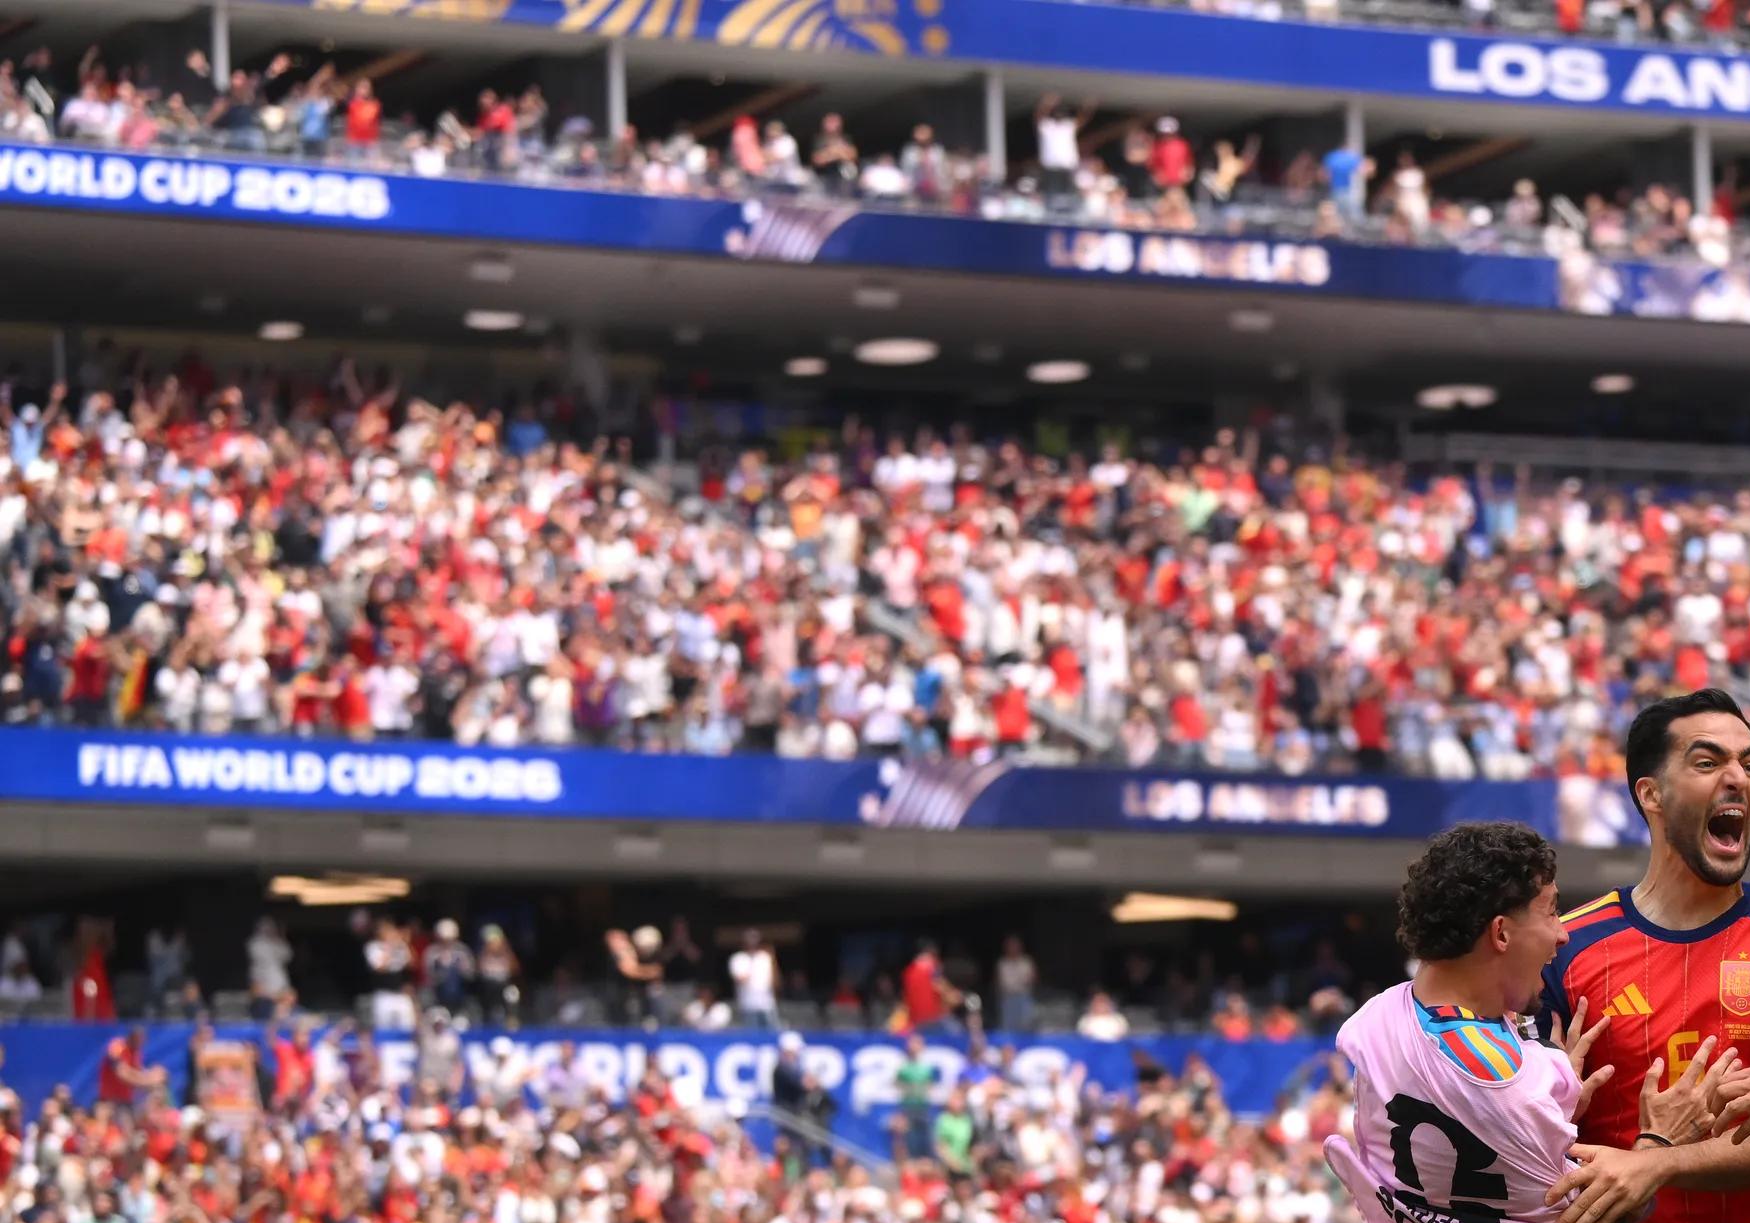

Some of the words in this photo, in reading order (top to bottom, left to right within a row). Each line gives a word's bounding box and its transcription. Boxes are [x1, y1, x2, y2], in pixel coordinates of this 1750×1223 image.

[1428, 40, 1608, 100] LOS
[139, 160, 231, 206] CUP
[232, 167, 391, 220] 2026
[78, 744, 172, 788] FIFA
[173, 748, 326, 793] WORLD
[328, 751, 413, 796] CUP
[414, 755, 562, 802] 2026
